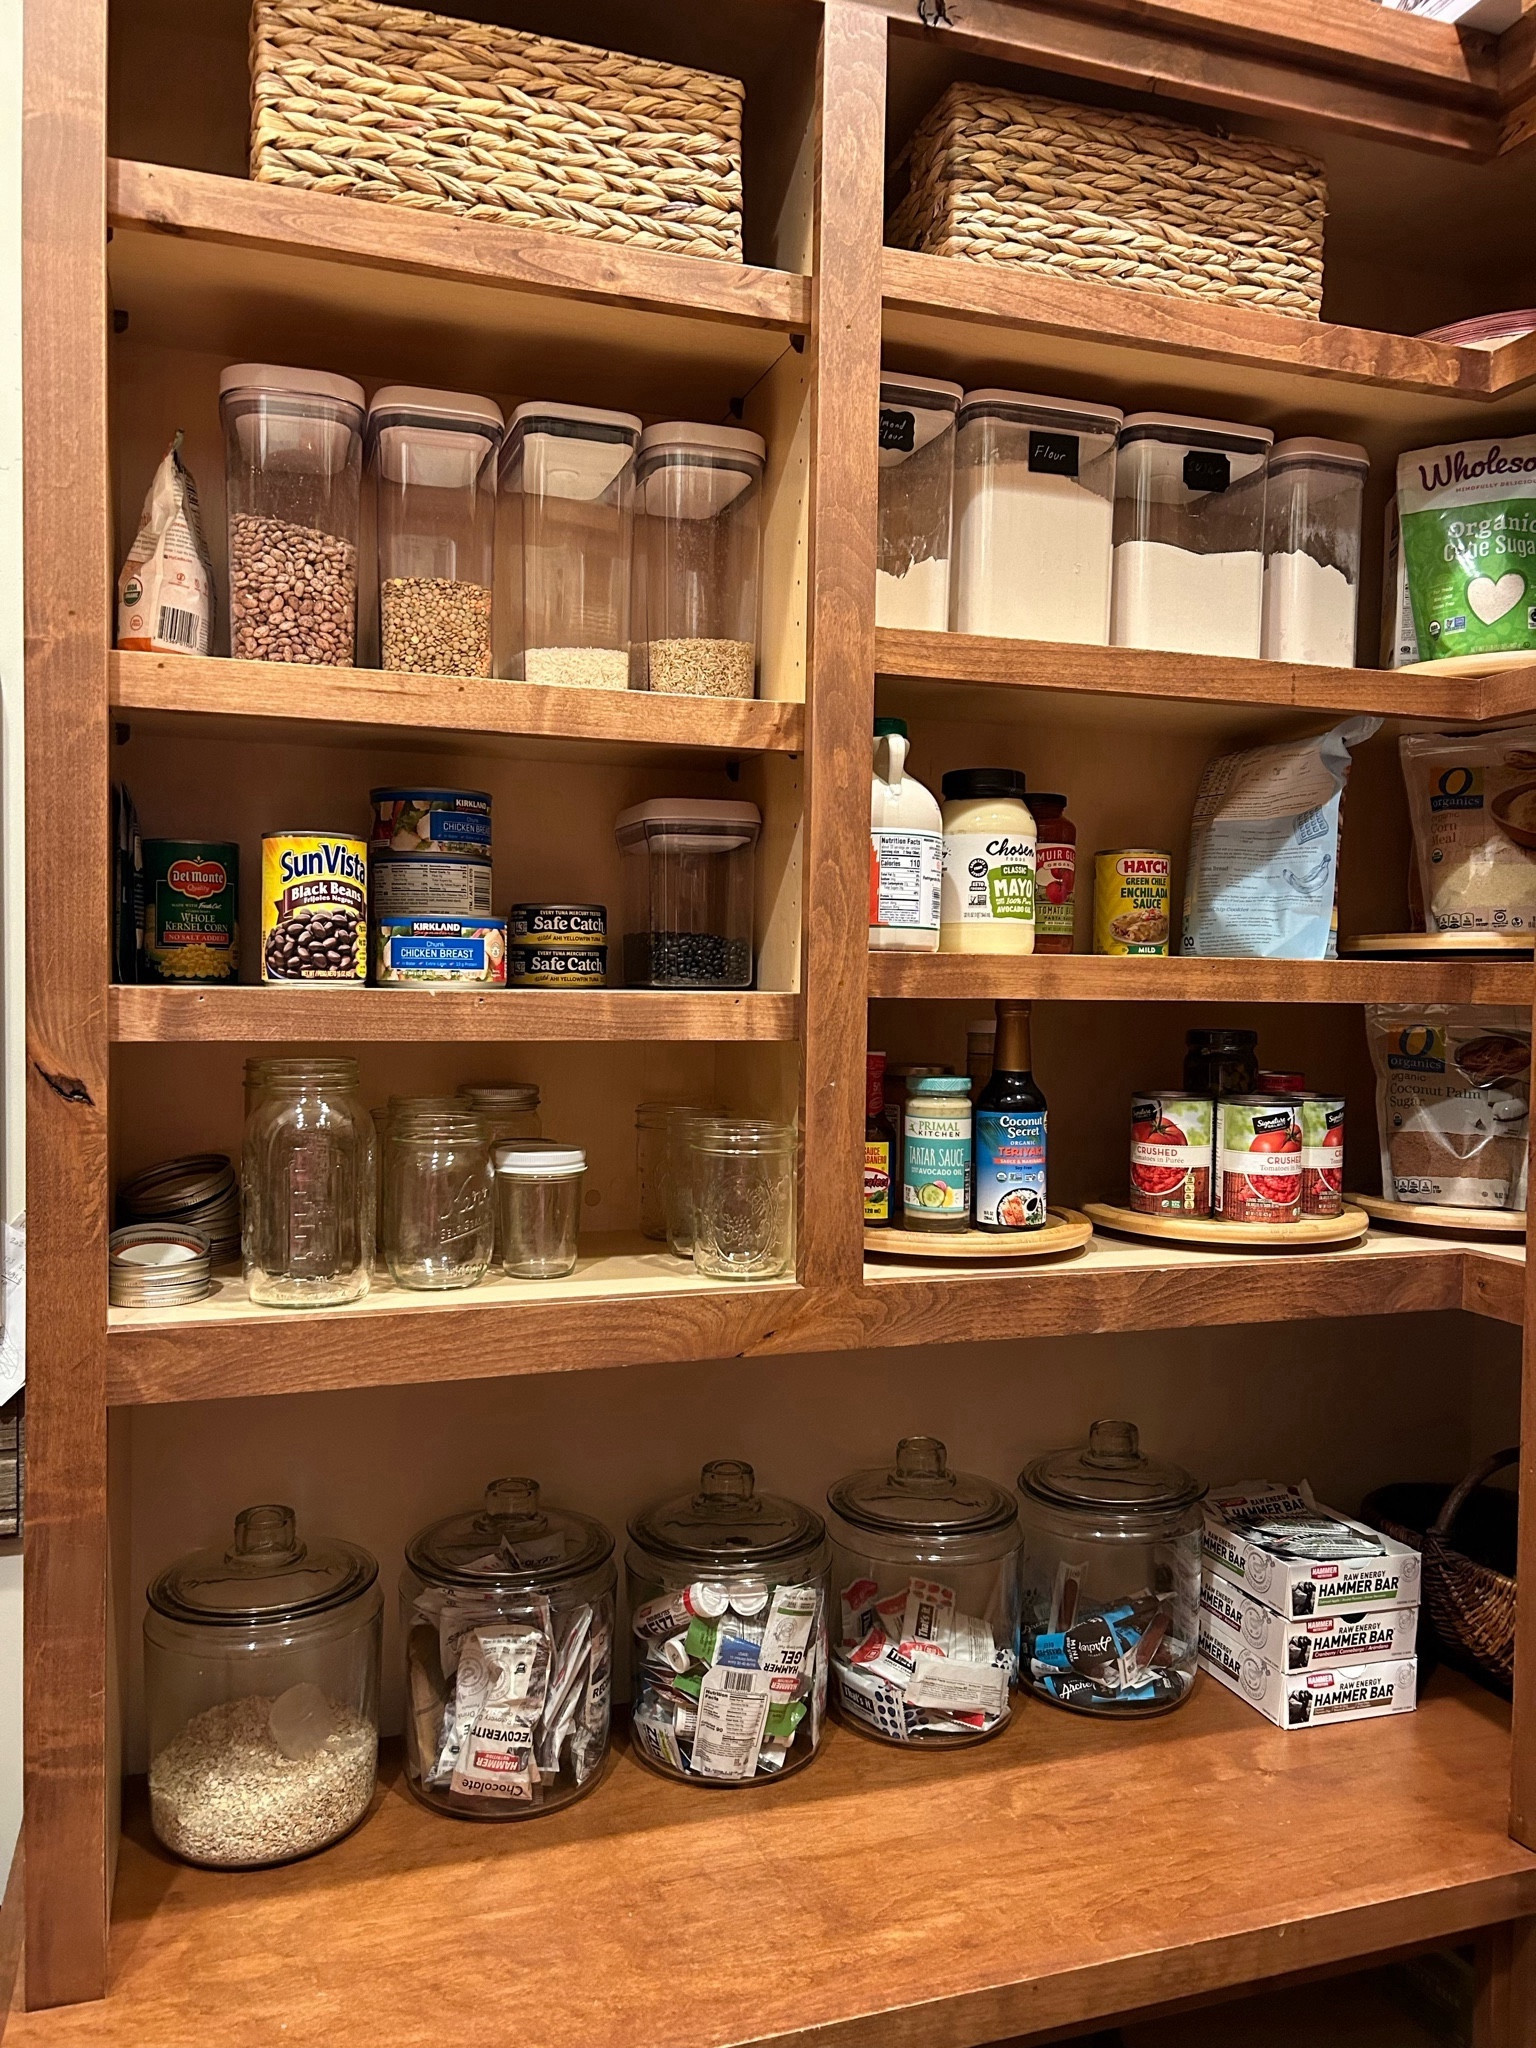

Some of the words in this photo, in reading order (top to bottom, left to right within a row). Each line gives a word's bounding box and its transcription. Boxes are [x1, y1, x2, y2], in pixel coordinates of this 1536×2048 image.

[1034, 444, 1066, 461] Flour
[1419, 445, 1536, 491] Wholeso
[1456, 482, 1498, 493] MINDFULLY
[1495, 534, 1536, 558] Suga
[455, 798, 487, 809] KIRKLAND
[1432, 795, 1481, 808] organics
[443, 822, 475, 832] CHICKEN
[1431, 823, 1457, 835] Corn
[881, 837, 906, 845] Nutrition
[907, 838, 921, 846] Facts
[1431, 833, 1456, 846] Meal
[986, 838, 1034, 857] Chosen
[1037, 850, 1062, 862] MUIR
[281, 844, 365, 885] SunVista
[910, 860, 921, 868] 110
[1123, 860, 1168, 874] HATCH
[172, 870, 190, 882] Del
[191, 871, 224, 884] Monte
[1126, 877, 1150, 886] GREEN
[1151, 878, 1166, 886] CHILE
[187, 884, 210, 892] Quality
[291, 881, 328, 901] Black
[330, 882, 362, 902] Beans
[993, 878, 1032, 898] MAYO
[303, 895, 331, 904] Frijoles
[1132, 899, 1162, 909] SAUCE
[997, 905, 1024, 913] AVOCADO
[1039, 906, 1064, 915] TOMATO
[180, 912, 216, 924] WHOLE
[165, 921, 203, 932] KERNEL
[204, 923, 228, 932] CORN
[413, 922, 461, 932] KIRKLAND
[533, 916, 568, 930] Safe
[570, 917, 605, 934] Catch
[201, 934, 226, 942] ADDED
[426, 940, 445, 948] Chunk
[400, 948, 437, 958] CHICKEN
[440, 949, 474, 959] BREAST
[531, 956, 565, 971] Safe
[567, 957, 604, 974] Catch
[1390, 1056, 1442, 1070] organics
[1390, 1083, 1443, 1097] Coconut
[1446, 1086, 1481, 1099] Palm
[1390, 1096, 1426, 1110] Sugar
[919, 1120, 960, 1132] PRIMAL
[1000, 1115, 1042, 1128] Coconut
[918, 1130, 960, 1138] KITCHEN
[1007, 1126, 1040, 1139] Secret
[909, 1145, 936, 1167] TARTAR
[938, 1147, 964, 1167] SAUCE
[998, 1146, 1043, 1158] TERIYAKI
[1137, 1146, 1178, 1157] CRUSHED
[918, 1167, 952, 1176] AVOCADO
[953, 1168, 963, 1176] OIL
[1260, 1164, 1289, 1172] Tomatoes
[1250, 1497, 1265, 1505] RAW
[1265, 1493, 1290, 1502] ENERGY
[1232, 1502, 1283, 1517] HAMMER
[1208, 1531, 1218, 1539] RAW
[1218, 1536, 1237, 1551] ENERGY
[1203, 1535, 1227, 1559] MMER
[1229, 1551, 1246, 1570] BAR
[1312, 1566, 1338, 1575] HAMMER
[1343, 1573, 1358, 1581] RAW
[1359, 1570, 1386, 1580] ENERGY
[1319, 1580, 1372, 1597] HAMMER
[1375, 1576, 1399, 1591] BAR
[1205, 1583, 1215, 1593] RAW
[1215, 1588, 1234, 1605] ENERGY
[1200, 1587, 1224, 1612] MMER
[1225, 1603, 1243, 1622] BAR
[1307, 1619, 1333, 1628] HAMMER
[1338, 1626, 1354, 1634] RAW
[1355, 1622, 1381, 1632] ENERGY
[1079, 1635, 1112, 1652] Archer
[1203, 1631, 1213, 1640] RAW
[1214, 1637, 1233, 1654] ENERGY
[1313, 1632, 1367, 1650] HAMMER
[1369, 1629, 1394, 1644] BAR
[1070, 1639, 1079, 1660] MINI
[1199, 1635, 1222, 1661] MMER
[1224, 1653, 1241, 1674] BAR
[1314, 1650, 1336, 1658] Cranberry
[781, 1650, 804, 1664] GEL
[763, 1662, 799, 1674] HAMMER
[1308, 1675, 1333, 1684] HAMMER
[1355, 1678, 1382, 1687] ENERGY
[770, 1681, 798, 1692] HAMMER
[705, 1689, 728, 1698] Nutrition
[705, 1694, 719, 1702] Facts
[1314, 1688, 1368, 1707] HAMMER
[1369, 1684, 1395, 1698] BAR
[476, 1756, 519, 1771] HAMMER
[462, 1779, 523, 1797] Chocolate
